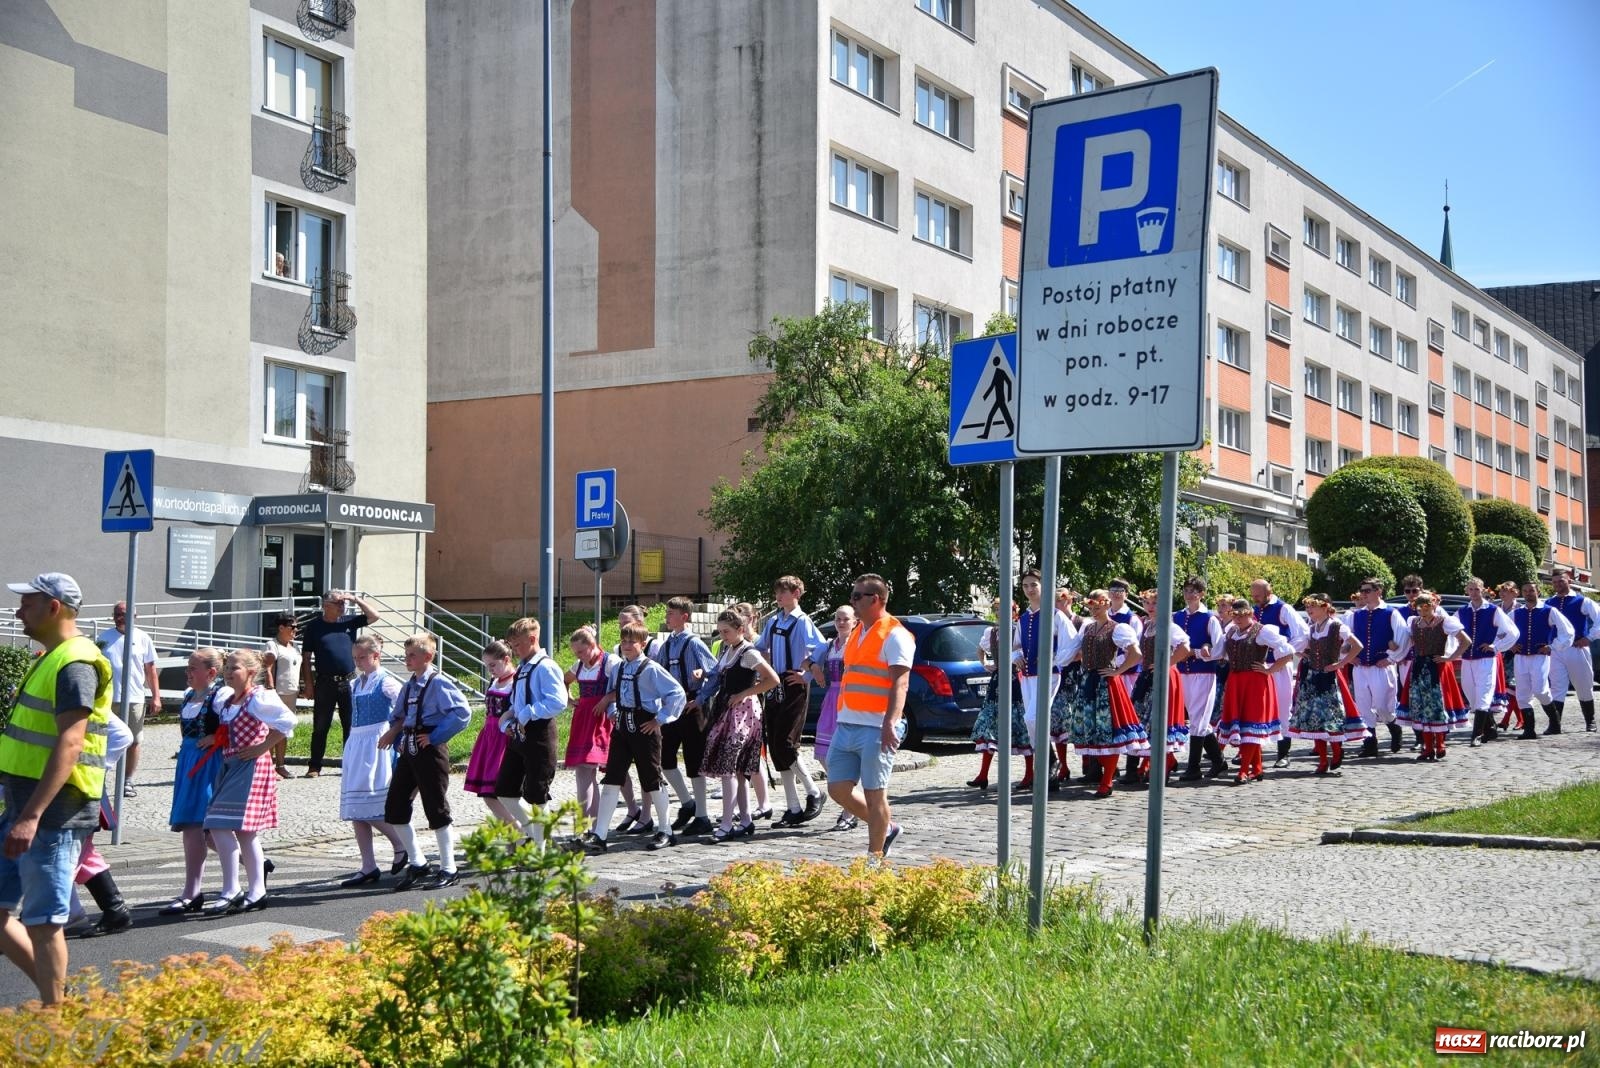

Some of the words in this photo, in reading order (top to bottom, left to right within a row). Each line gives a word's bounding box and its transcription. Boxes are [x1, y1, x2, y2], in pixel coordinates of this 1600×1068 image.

[1078, 128, 1151, 246] P
[1042, 281, 1101, 305] Postój
[1110, 276, 1177, 303] płatny
[1036, 328, 1050, 341] w
[1058, 319, 1088, 339] dni
[1097, 315, 1178, 336] robocze
[1066, 355, 1108, 376] pon.
[1136, 345, 1163, 370] pt.
[1044, 394, 1057, 408] w
[1065, 388, 1118, 413] godz.
[1128, 385, 1170, 406] 9-17
[258, 503, 322, 516] ORTODONCJA
[339, 503, 423, 523] ORTODONCJA
[584, 477, 606, 522] P
